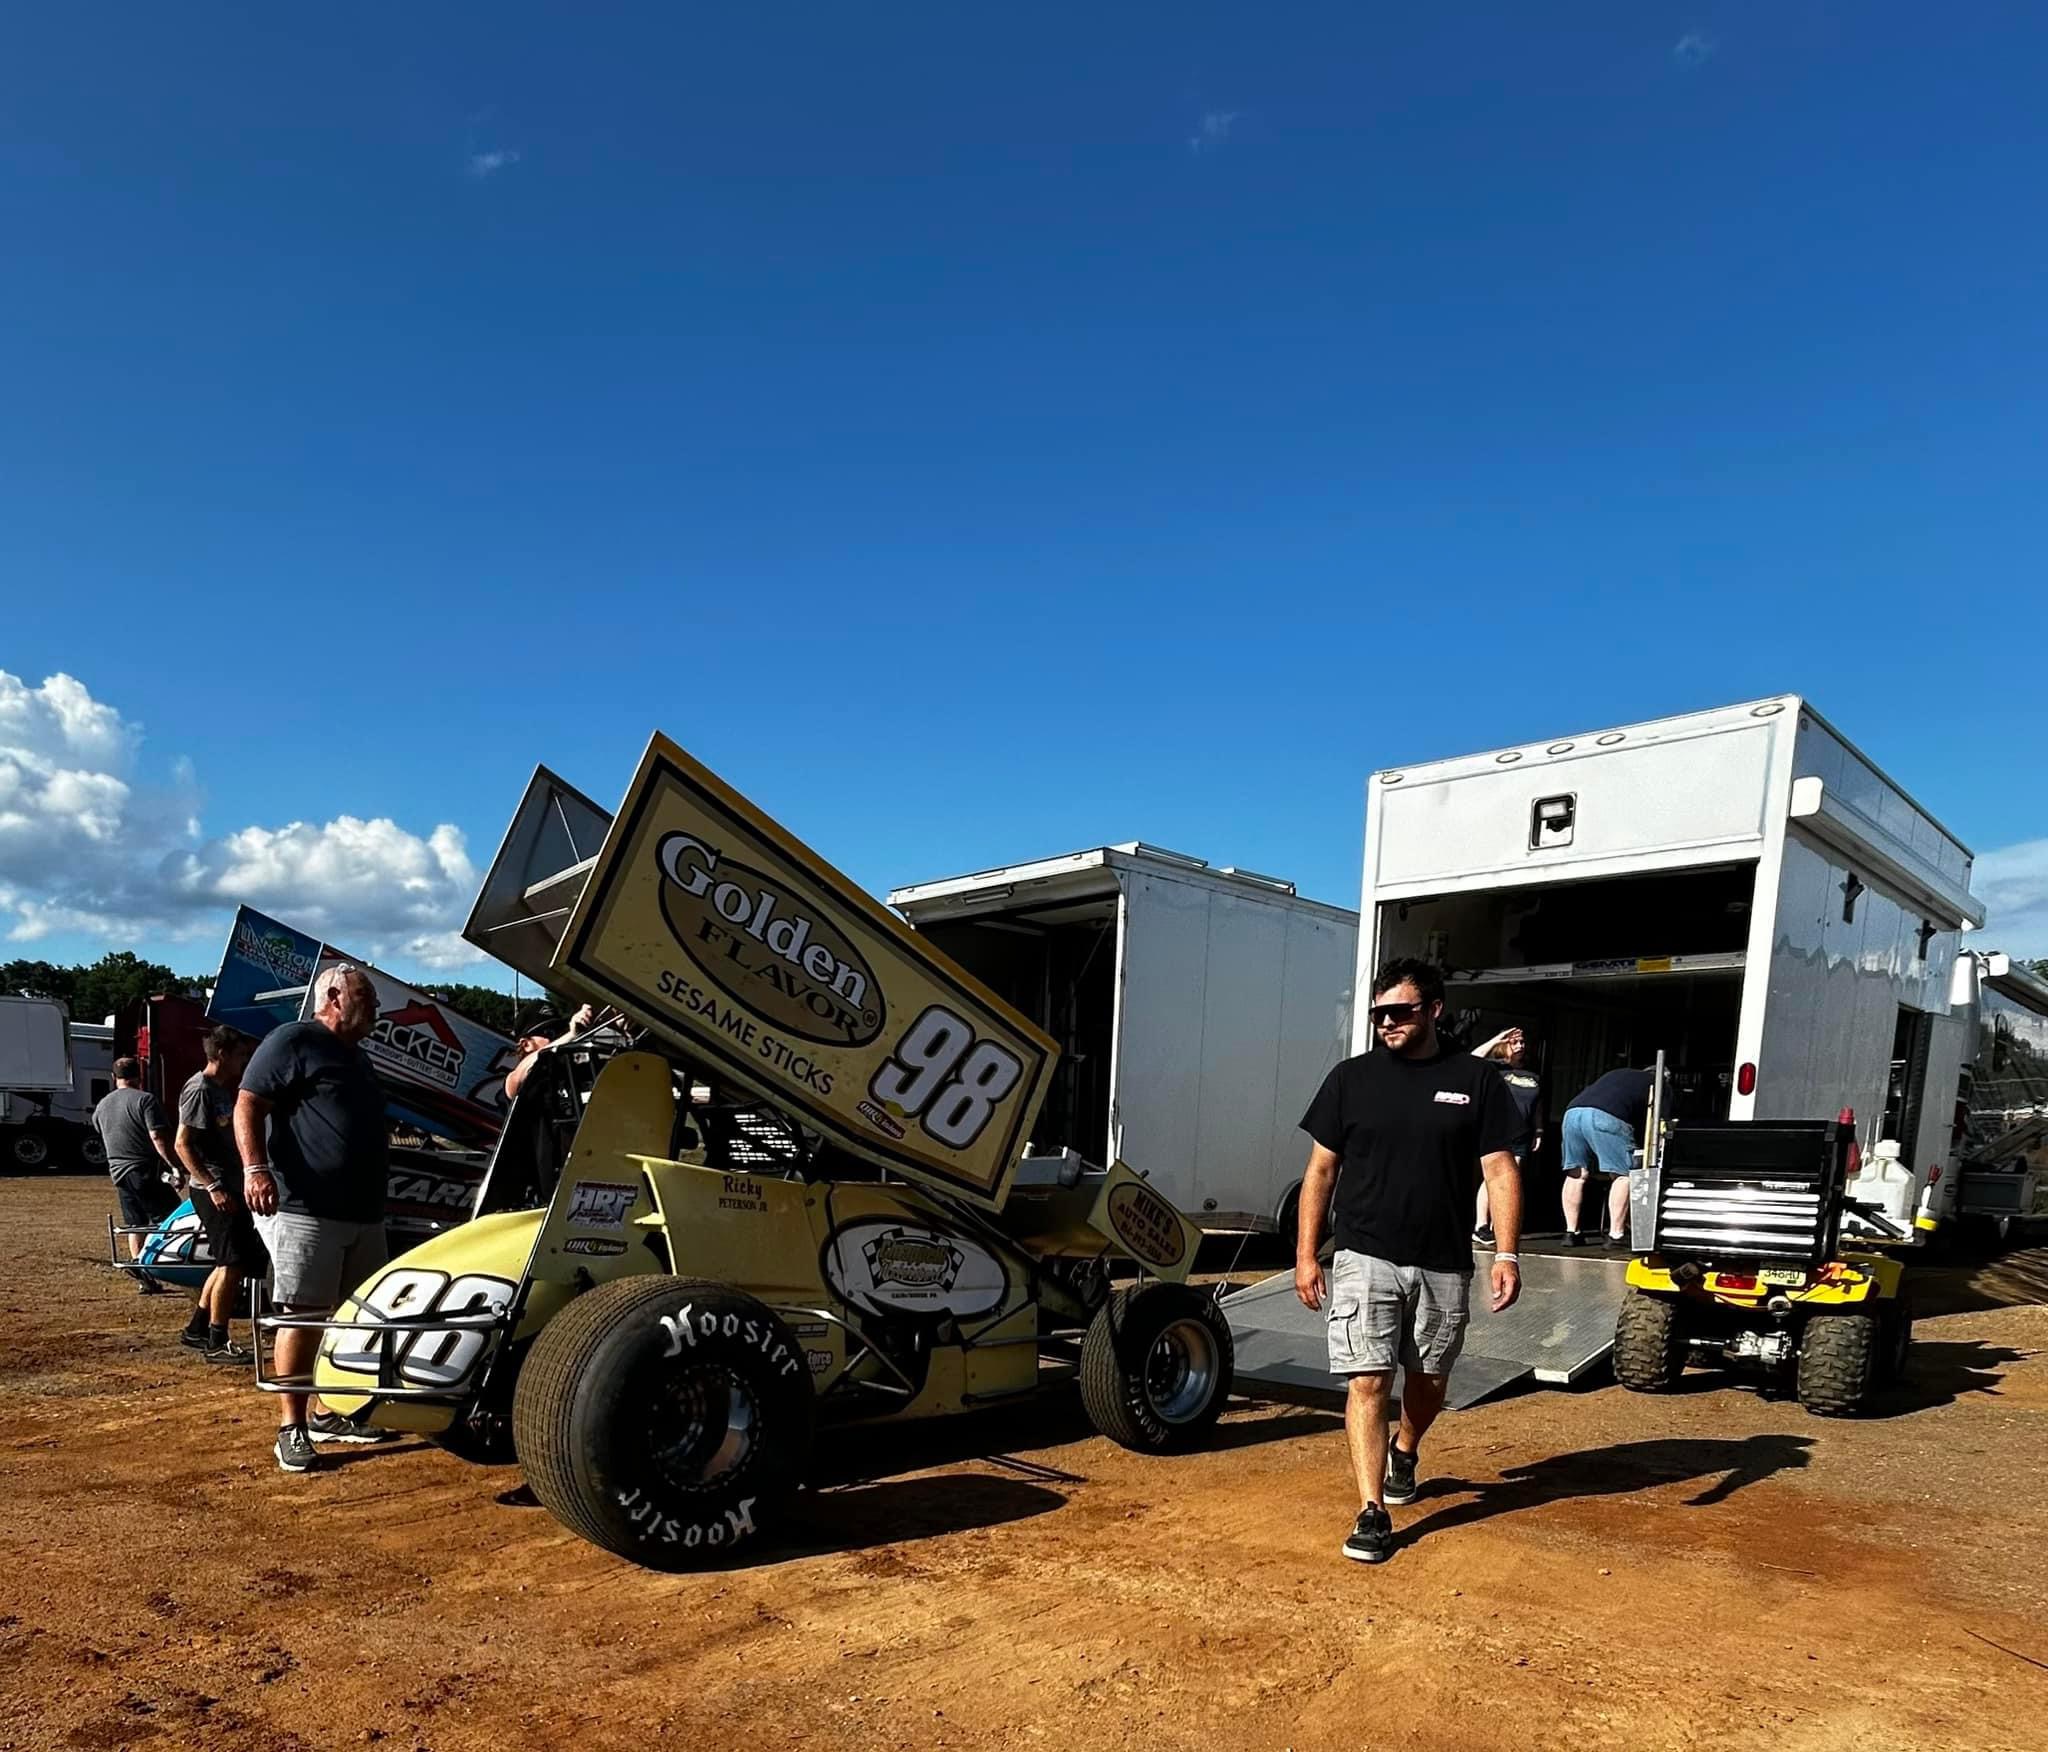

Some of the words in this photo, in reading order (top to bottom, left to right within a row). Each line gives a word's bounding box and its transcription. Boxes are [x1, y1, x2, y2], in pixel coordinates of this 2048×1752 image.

[660, 834, 869, 1010] Golden
[695, 914, 860, 1043] FLAVOR
[369, 1018, 465, 1075] ACKER
[656, 969, 758, 1049] SESAME
[757, 1035, 835, 1097] STICKS
[869, 1004, 1022, 1149] 98
[567, 1188, 637, 1221] HRF
[718, 1198, 757, 1211] PETERSON
[722, 1175, 763, 1200] Ricky
[1133, 1190, 1174, 1235] MIKE'S
[1117, 1203, 1146, 1230] AUTO
[1146, 1227, 1177, 1258] SALES
[659, 1302, 799, 1376] Hoosier
[1125, 1373, 1169, 1445] Hoosier
[617, 1487, 758, 1548] Hoosier
